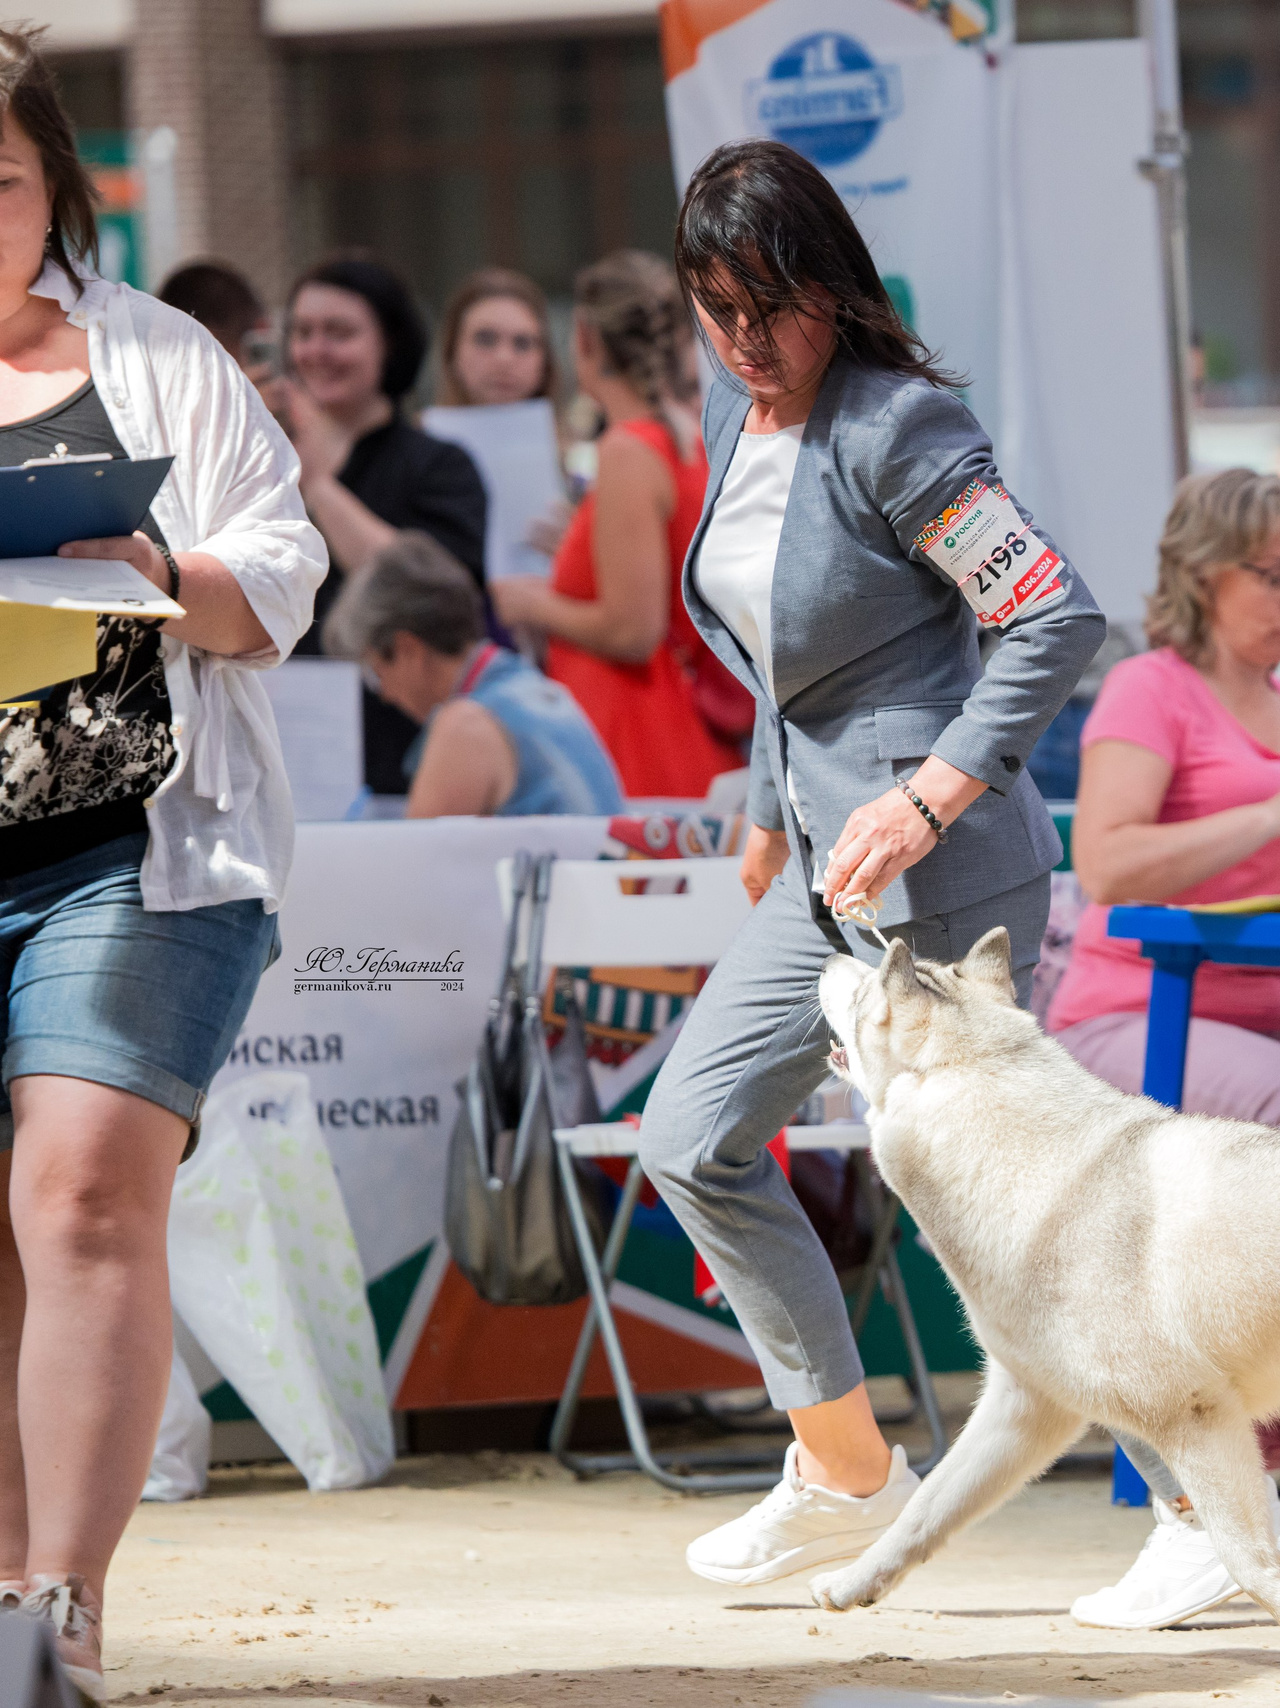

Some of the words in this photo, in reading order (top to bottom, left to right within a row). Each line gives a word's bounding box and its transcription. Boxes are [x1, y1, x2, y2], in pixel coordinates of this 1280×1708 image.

[955, 509, 983, 539] РОССИЯ
[966, 531, 1027, 595] 2198
[1018, 556, 1053, 595] 9.06.2024
